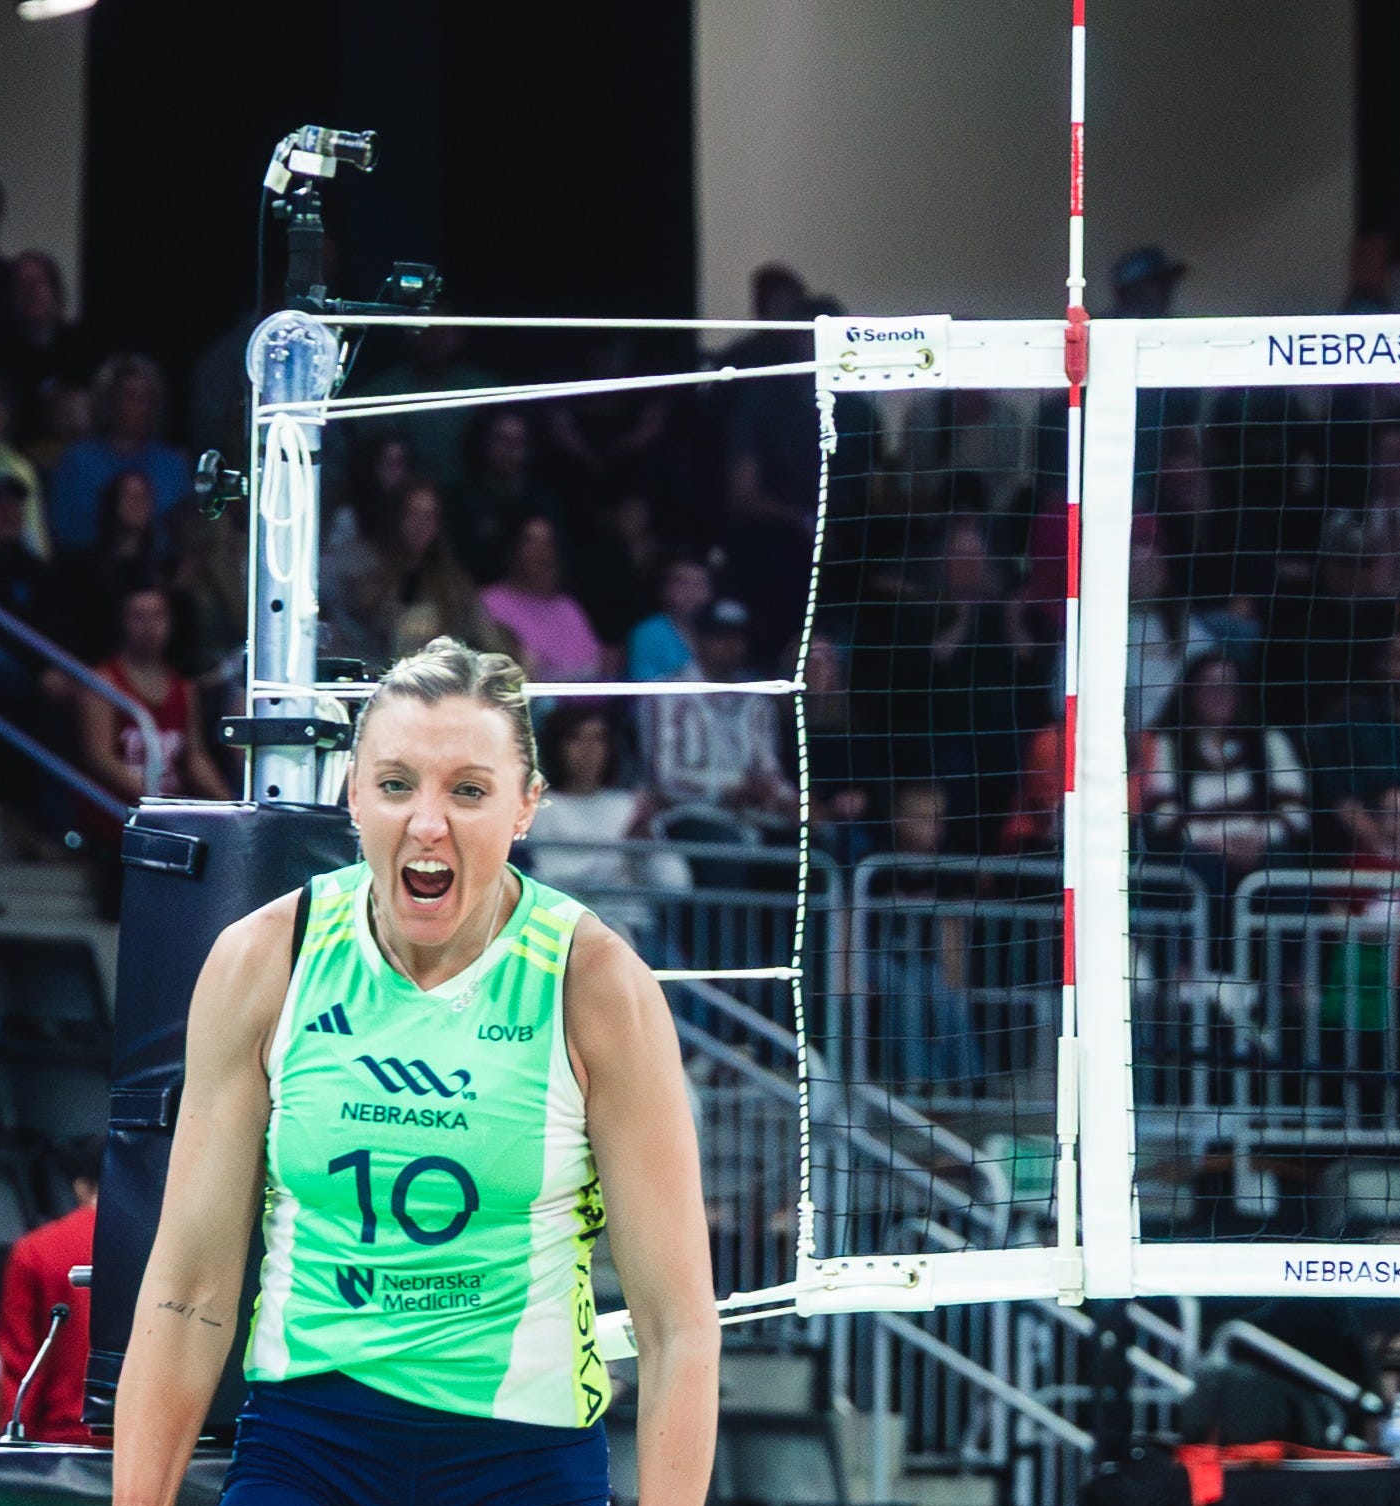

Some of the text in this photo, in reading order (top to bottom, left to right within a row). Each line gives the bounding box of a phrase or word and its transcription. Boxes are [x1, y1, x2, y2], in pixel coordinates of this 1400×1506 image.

[863, 328, 925, 342] Senoh
[477, 1024, 534, 1043] LOVB
[340, 1102, 470, 1131] NEBRASKA
[328, 1149, 480, 1246] 10
[381, 1272, 482, 1291] Nebraska
[381, 1293, 482, 1312] Medicine
